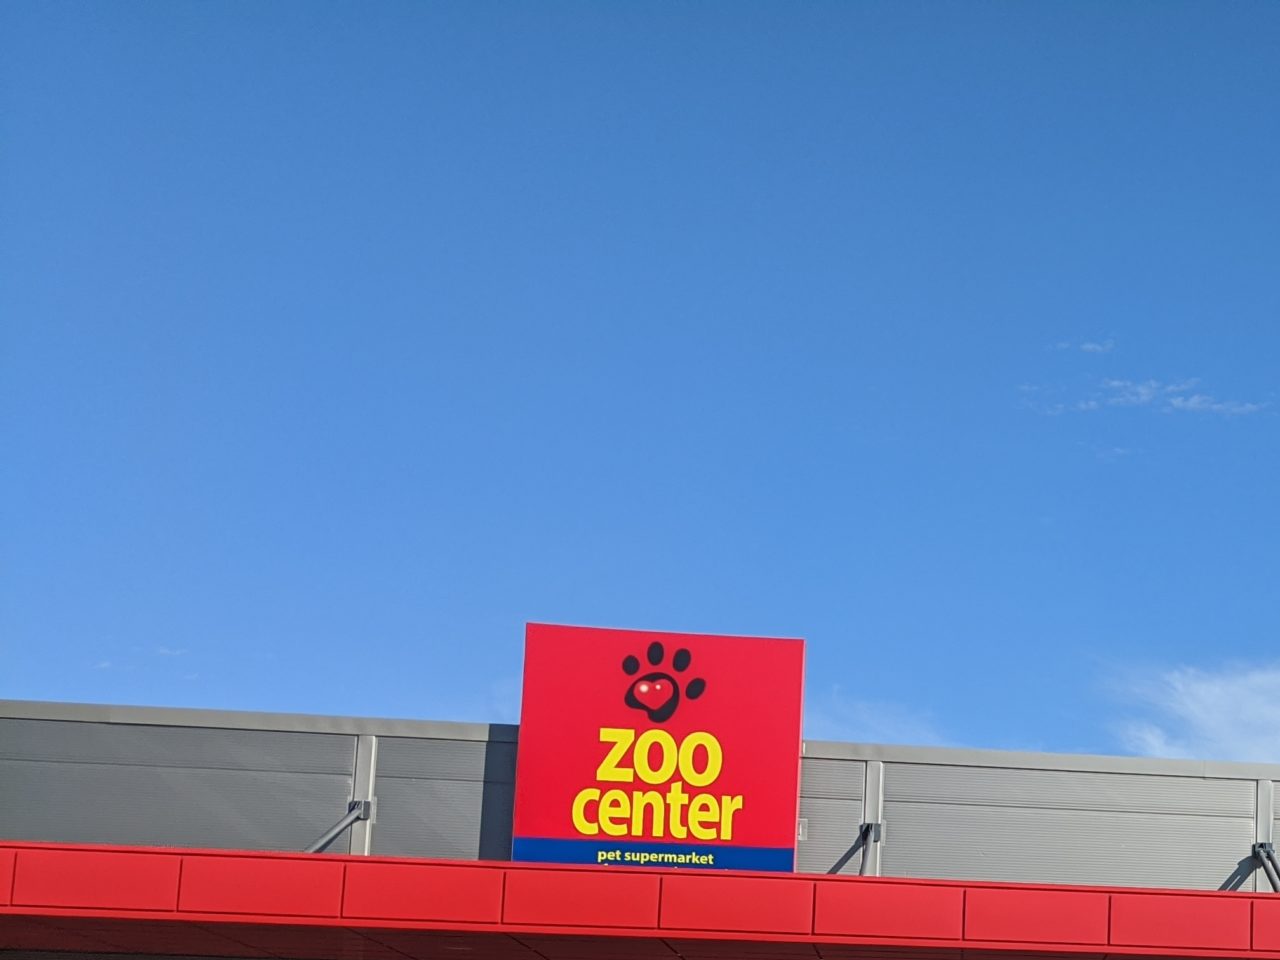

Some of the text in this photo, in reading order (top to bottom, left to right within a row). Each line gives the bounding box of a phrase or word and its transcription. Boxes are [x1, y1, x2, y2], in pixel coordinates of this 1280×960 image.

[572, 781, 743, 841] center
[597, 850, 714, 865] pet supermarket
